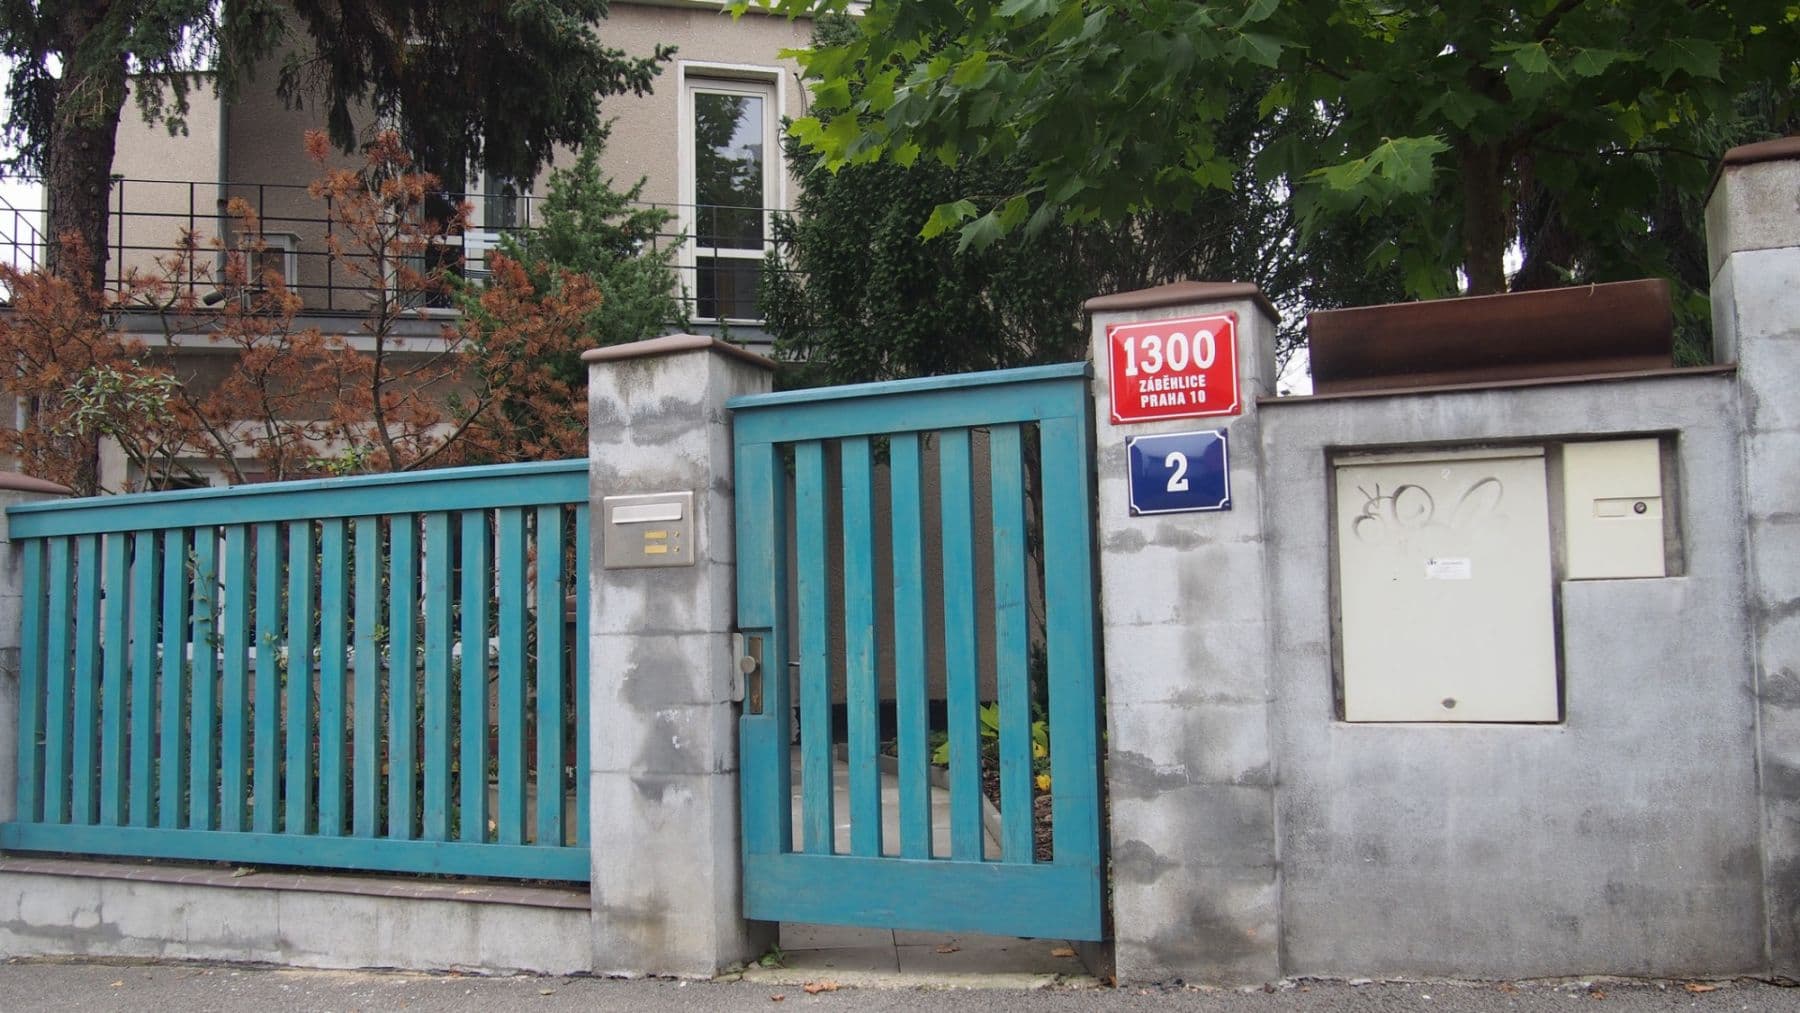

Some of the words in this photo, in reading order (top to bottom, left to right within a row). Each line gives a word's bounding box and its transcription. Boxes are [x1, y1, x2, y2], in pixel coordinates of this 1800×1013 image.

[1123, 329, 1216, 377] 1300
[1139, 374, 1206, 393] ZÁBĚHLICE
[1140, 390, 1186, 409] PRAHA
[1190, 389, 1206, 404] 10
[1164, 451, 1189, 492] 2
